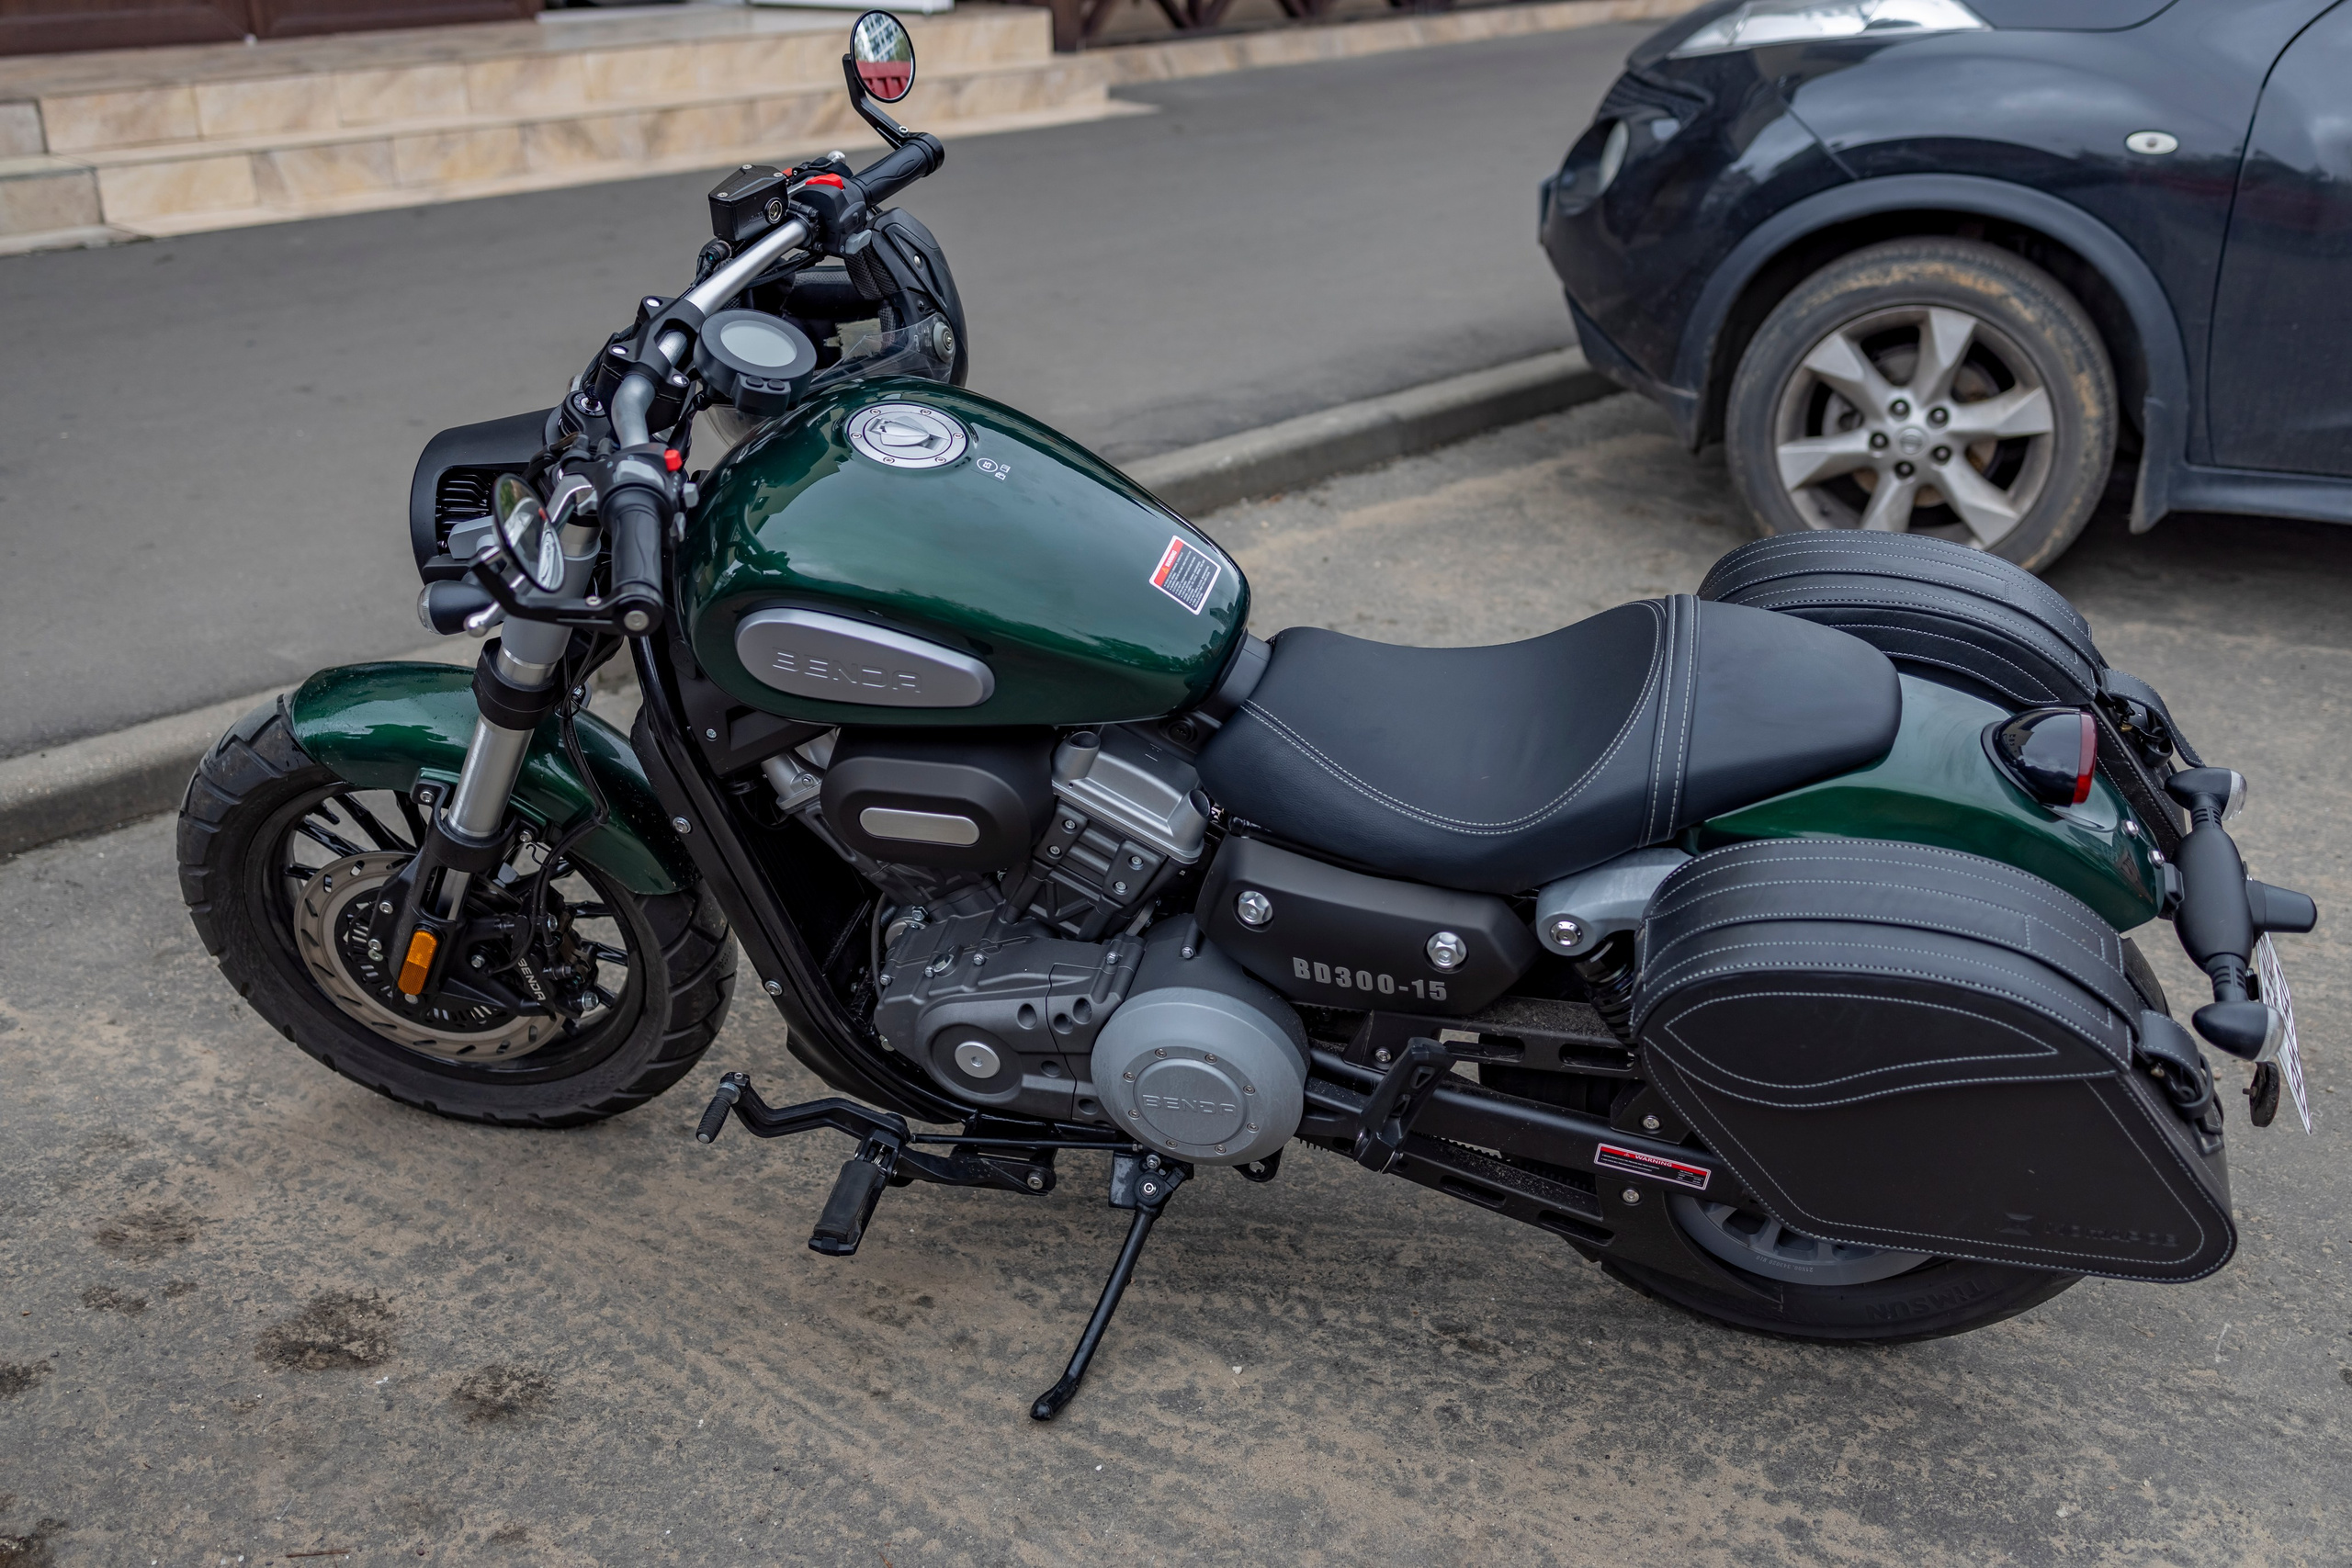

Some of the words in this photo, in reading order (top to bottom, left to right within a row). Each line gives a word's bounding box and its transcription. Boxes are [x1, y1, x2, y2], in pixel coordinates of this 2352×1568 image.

[772, 647, 923, 694] BENDA
[517, 957, 547, 1001] BENDA
[1293, 956, 1447, 1001] BD300-15
[1142, 1094, 1238, 1117] BENDA
[1634, 1154, 1673, 1168] WARNING
[1865, 1280, 1986, 1321] TIMSUN
